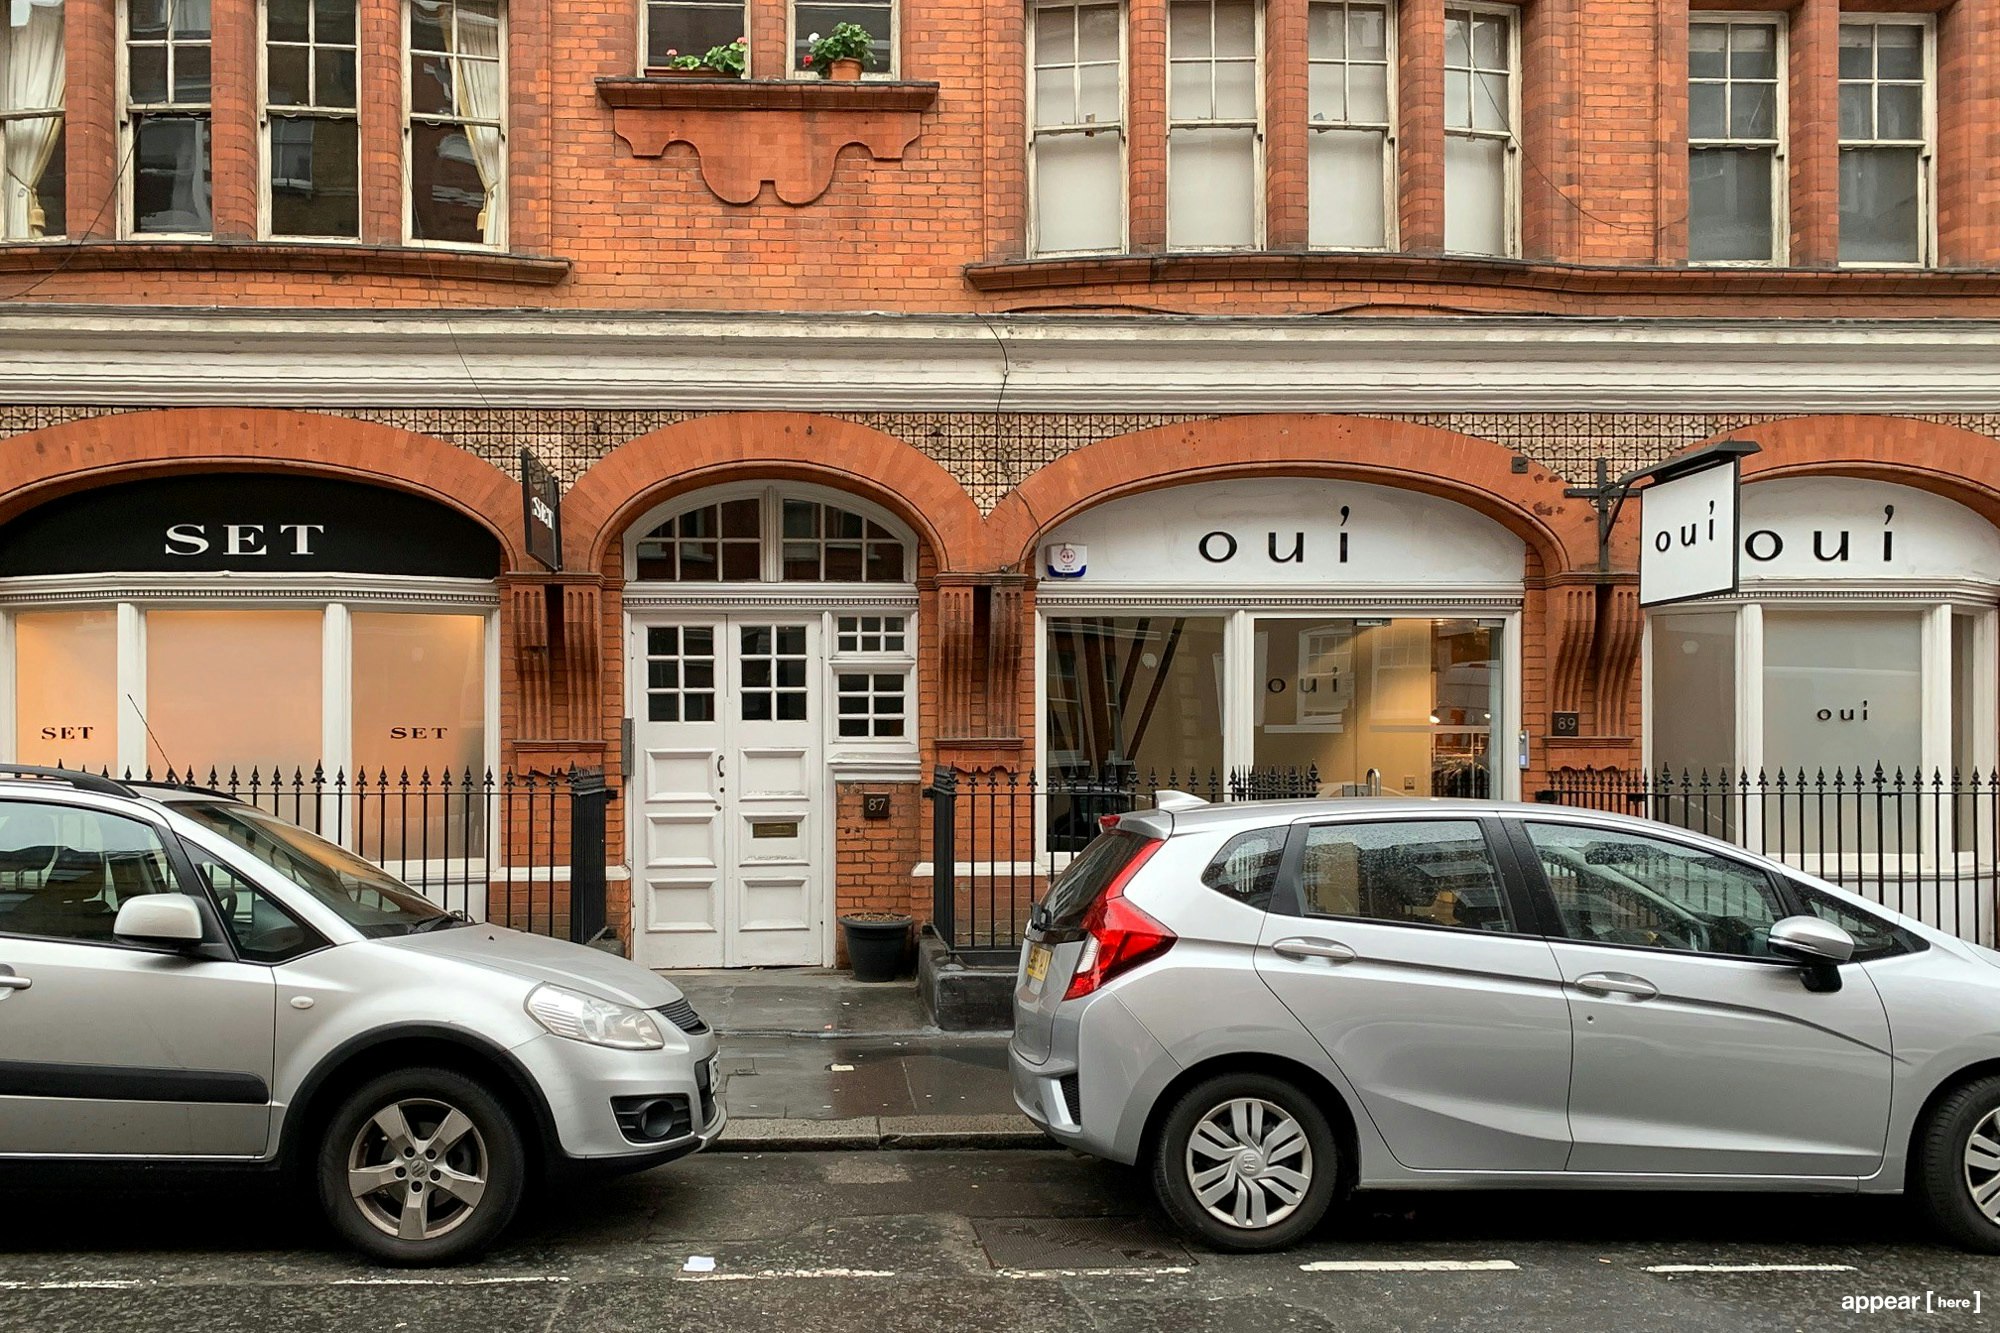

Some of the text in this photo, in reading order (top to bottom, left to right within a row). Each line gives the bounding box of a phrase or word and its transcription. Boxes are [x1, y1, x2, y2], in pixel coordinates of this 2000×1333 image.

[531, 496, 554, 530] SET
[1655, 500, 1715, 552] oui
[165, 523, 325, 556] SET
[1198, 505, 1351, 564] oui
[1745, 504, 1895, 562] oui
[1267, 666, 1338, 693] oui
[1558, 717, 1576, 730] 89
[1816, 700, 1868, 721] oui
[41, 726, 94, 740] SET
[390, 727, 448, 740] SET
[868, 798, 886, 811] 87
